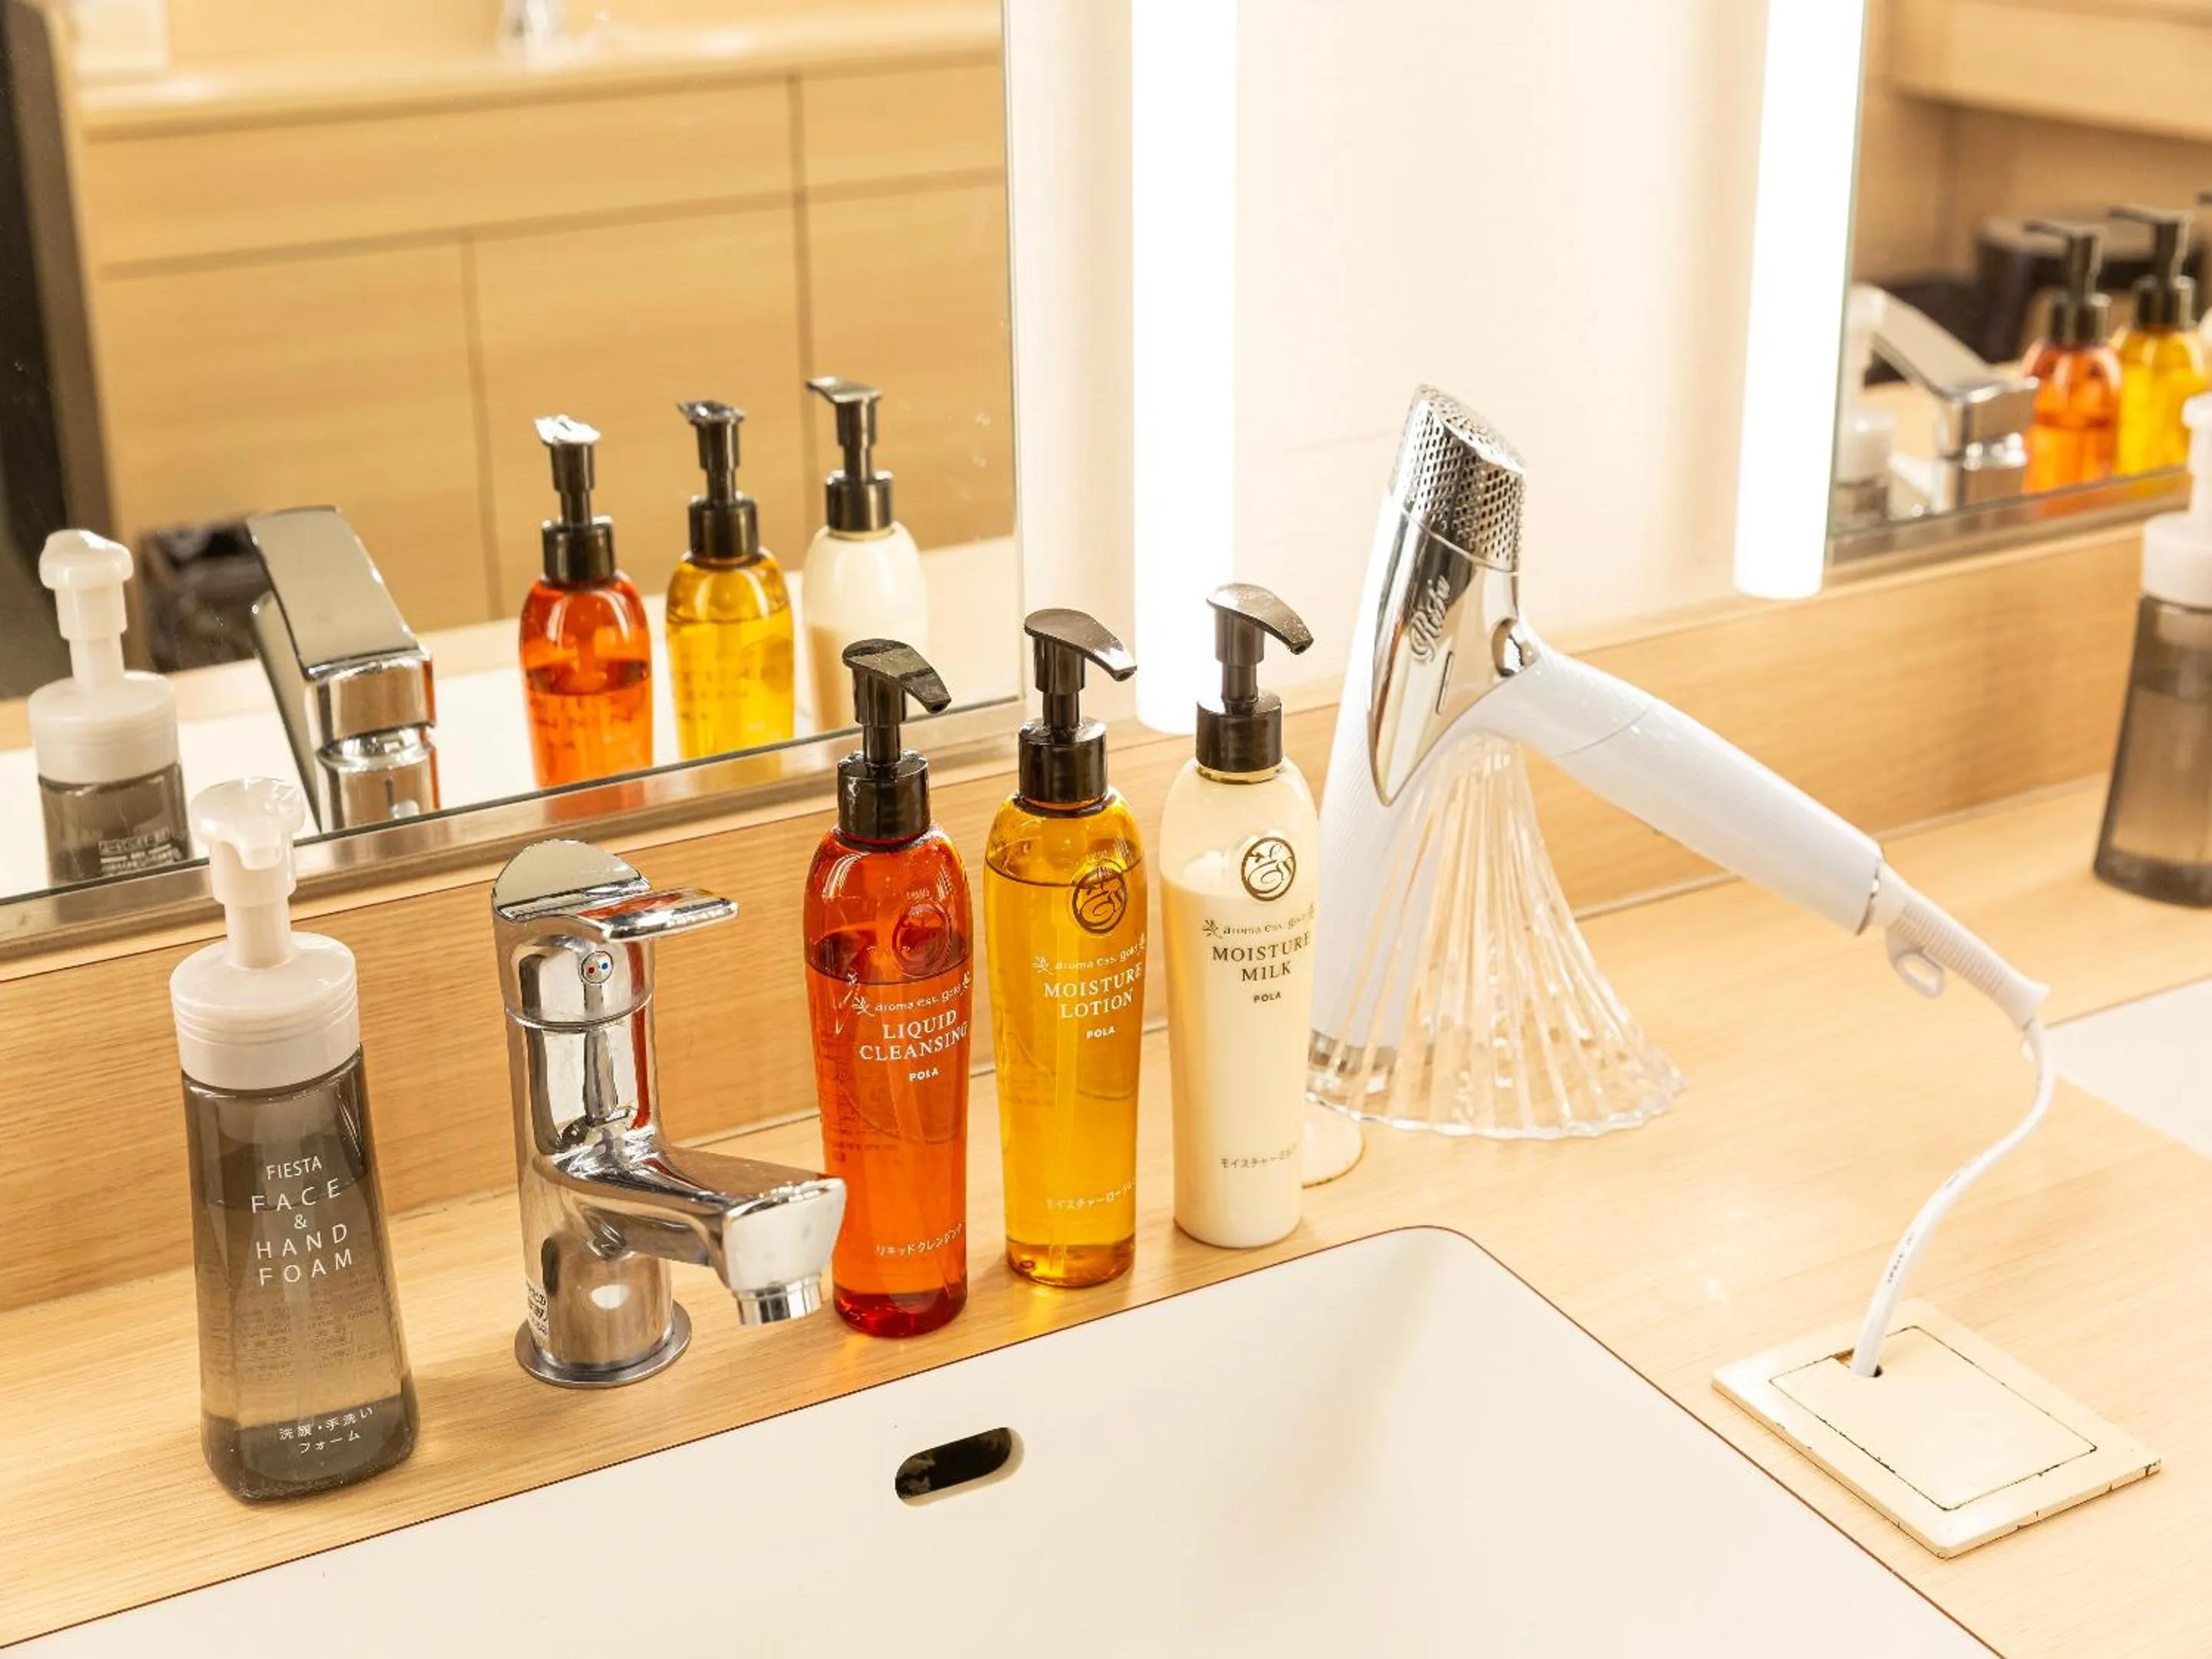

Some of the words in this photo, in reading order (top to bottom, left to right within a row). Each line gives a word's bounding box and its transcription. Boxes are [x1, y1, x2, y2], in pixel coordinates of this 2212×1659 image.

[1212, 932, 1310, 961] MOISTURE
[1044, 962, 1142, 998] MOISTURE
[1242, 960, 1292, 982] MILK
[1061, 988, 1134, 1018] LOTION
[1253, 992, 1282, 1003] POLA
[883, 1009, 957, 1039] LIQUID
[1086, 1025, 1116, 1039] POLA
[859, 1022, 969, 1061] CLEANSING
[909, 1068, 939, 1081] POLA
[266, 1154, 323, 1181] FIESTA
[251, 1177, 342, 1214] FACE
[294, 1214, 308, 1229] &
[256, 1223, 348, 1260] HAND
[259, 1248, 353, 1286] FOAM
[299, 1429, 361, 1455] フォーム
